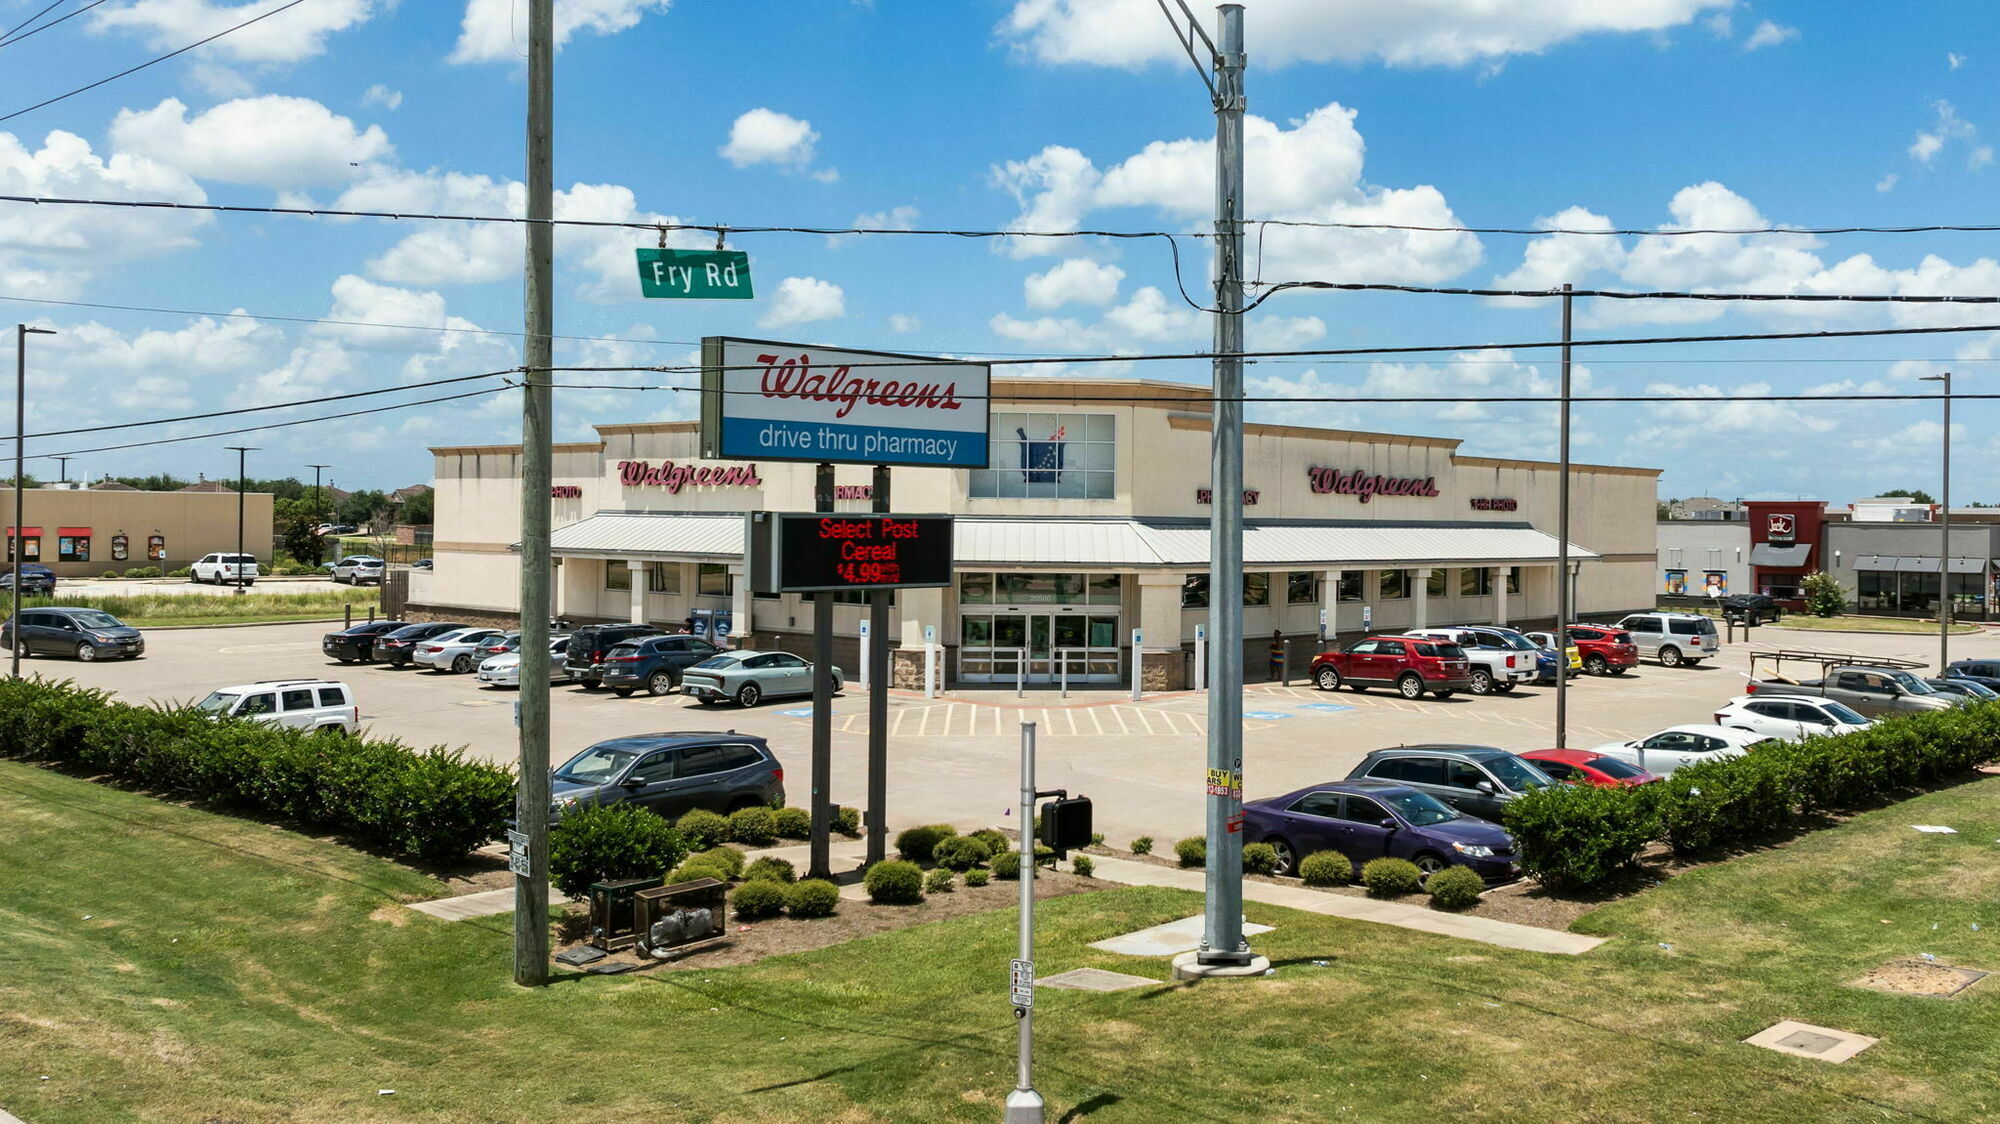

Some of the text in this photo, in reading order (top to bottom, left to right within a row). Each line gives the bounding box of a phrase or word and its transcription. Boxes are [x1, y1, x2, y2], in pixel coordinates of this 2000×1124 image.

[652, 261, 739, 293] Fry Rd
[757, 354, 962, 418] Walgreens
[759, 424, 957, 460] drive thru pharmacy
[617, 460, 763, 494] Walgreens
[1308, 467, 1440, 503] Walgreens
[819, 518, 919, 538] Select Post
[841, 541, 896, 560] Cereal
[836, 563, 880, 583] $4.99
[1207, 777, 1221, 785] ARS
[1211, 770, 1228, 778] BUY
